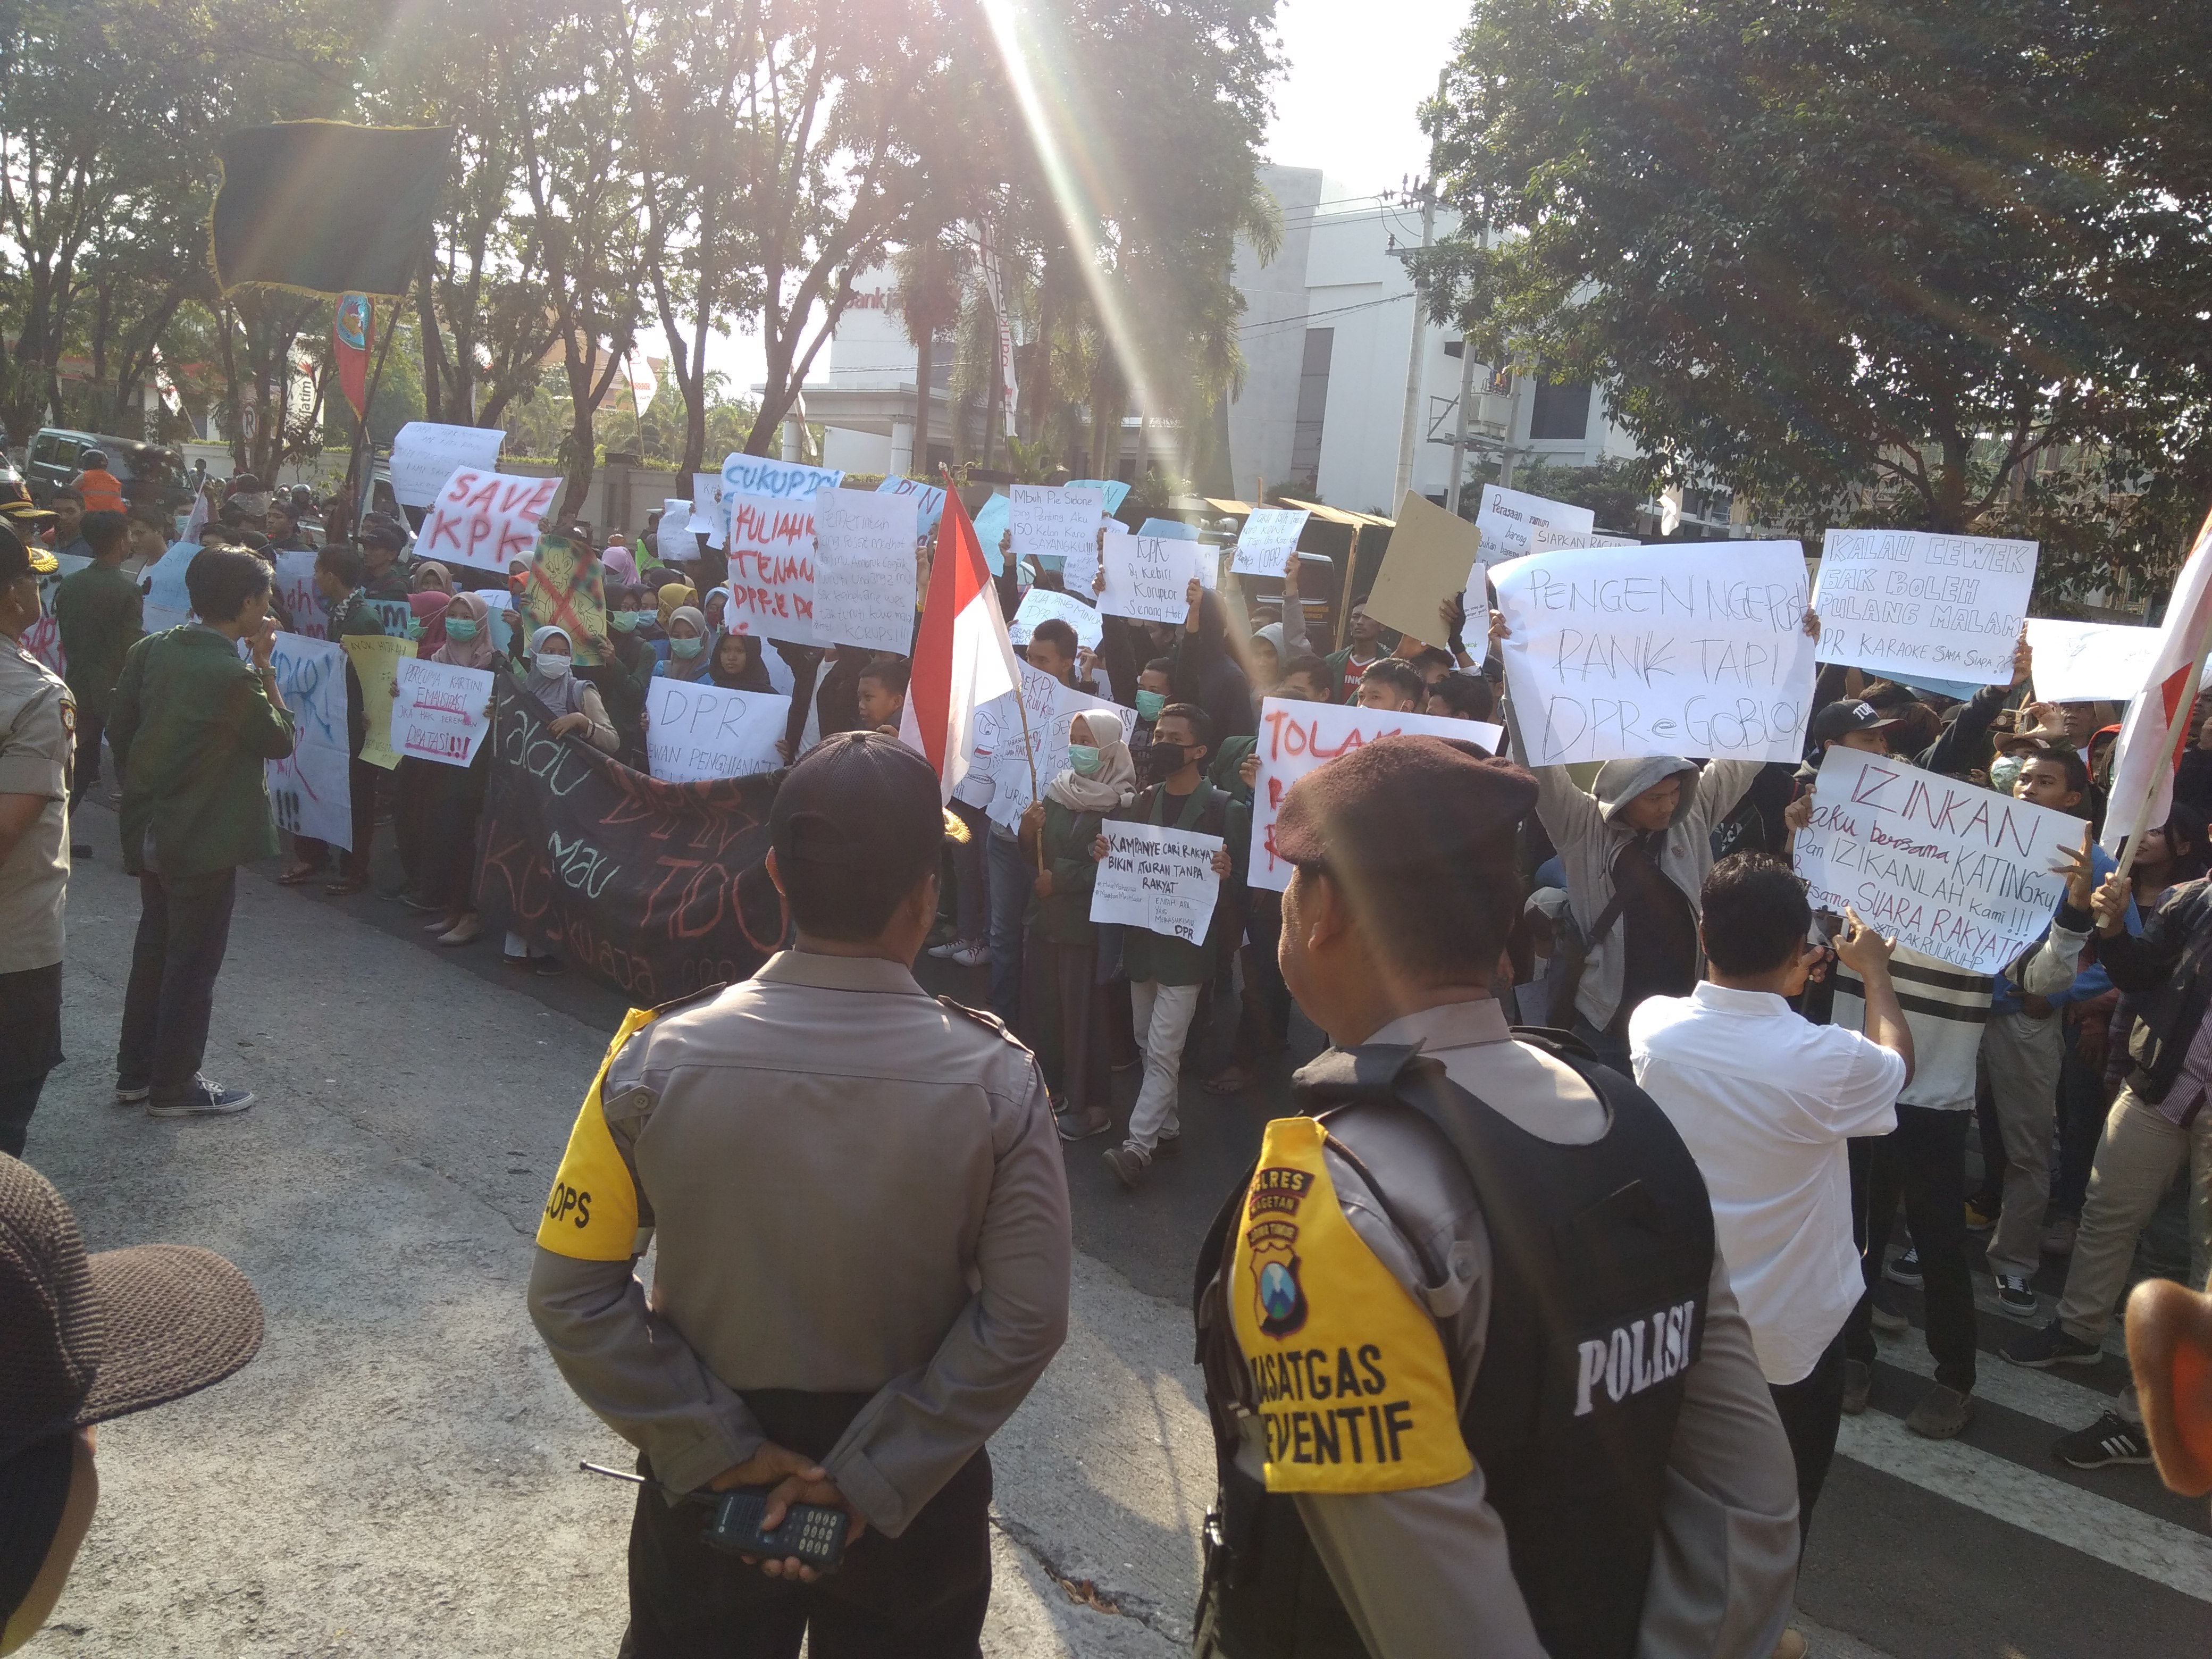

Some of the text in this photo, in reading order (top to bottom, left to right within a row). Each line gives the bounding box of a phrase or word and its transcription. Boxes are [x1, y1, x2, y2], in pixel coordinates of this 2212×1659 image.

[725, 464, 806, 498] CUKUP
[447, 473, 560, 524] SAVE
[1015, 490, 1042, 504] Mbuh
[1047, 490, 1061, 505] Pie
[1064, 491, 1093, 506] Sidone
[1492, 493, 1523, 523] Perasaan
[1034, 506, 1064, 523] Penting
[1070, 511, 1088, 524] Aku
[428, 508, 534, 564] KPK
[1064, 526, 1085, 539] Karo
[1504, 524, 1527, 547] bareng
[1537, 530, 1586, 548] SIAPKAN
[1829, 534, 2030, 574] KALAU CEWEK
[1027, 591, 1050, 605] GUA
[1051, 593, 1074, 609] YANG
[1523, 568, 1695, 618] PENGEN
[1821, 568, 1980, 605] GAK BOLEH
[1025, 605, 1052, 619] DPR
[1815, 592, 2024, 639] PULANG MALAM
[1552, 627, 1779, 689] RANK TAPI
[1858, 632, 1931, 659] KARAOKE
[404, 664, 483, 697] PERCUMA KARTINI
[398, 705, 413, 720] JIKA
[420, 710, 434, 721] HAK
[416, 686, 468, 712] EMANSIPASI
[660, 689, 747, 740] DPR
[1264, 709, 1402, 761] TOLA
[1683, 694, 1814, 752] GOBLOK
[1850, 763, 2042, 858] IZINKAN
[1108, 833, 1163, 858] KAMPANYE
[1162, 841, 1180, 858] CARI
[1796, 826, 1825, 859] Dan
[1808, 803, 1859, 837] aku
[1870, 819, 1950, 864] bersama
[1108, 856, 1204, 881] BIKIN ATURAN TANPA
[1142, 876, 1179, 894] RAKYAT
[1155, 896, 1176, 907] ENTAH
[1174, 925, 1194, 941] DPR
[1857, 882, 1922, 935] SUARA
[1930, 909, 2018, 966] RAKYAT
[1573, 1300, 1695, 1418] POLISI
